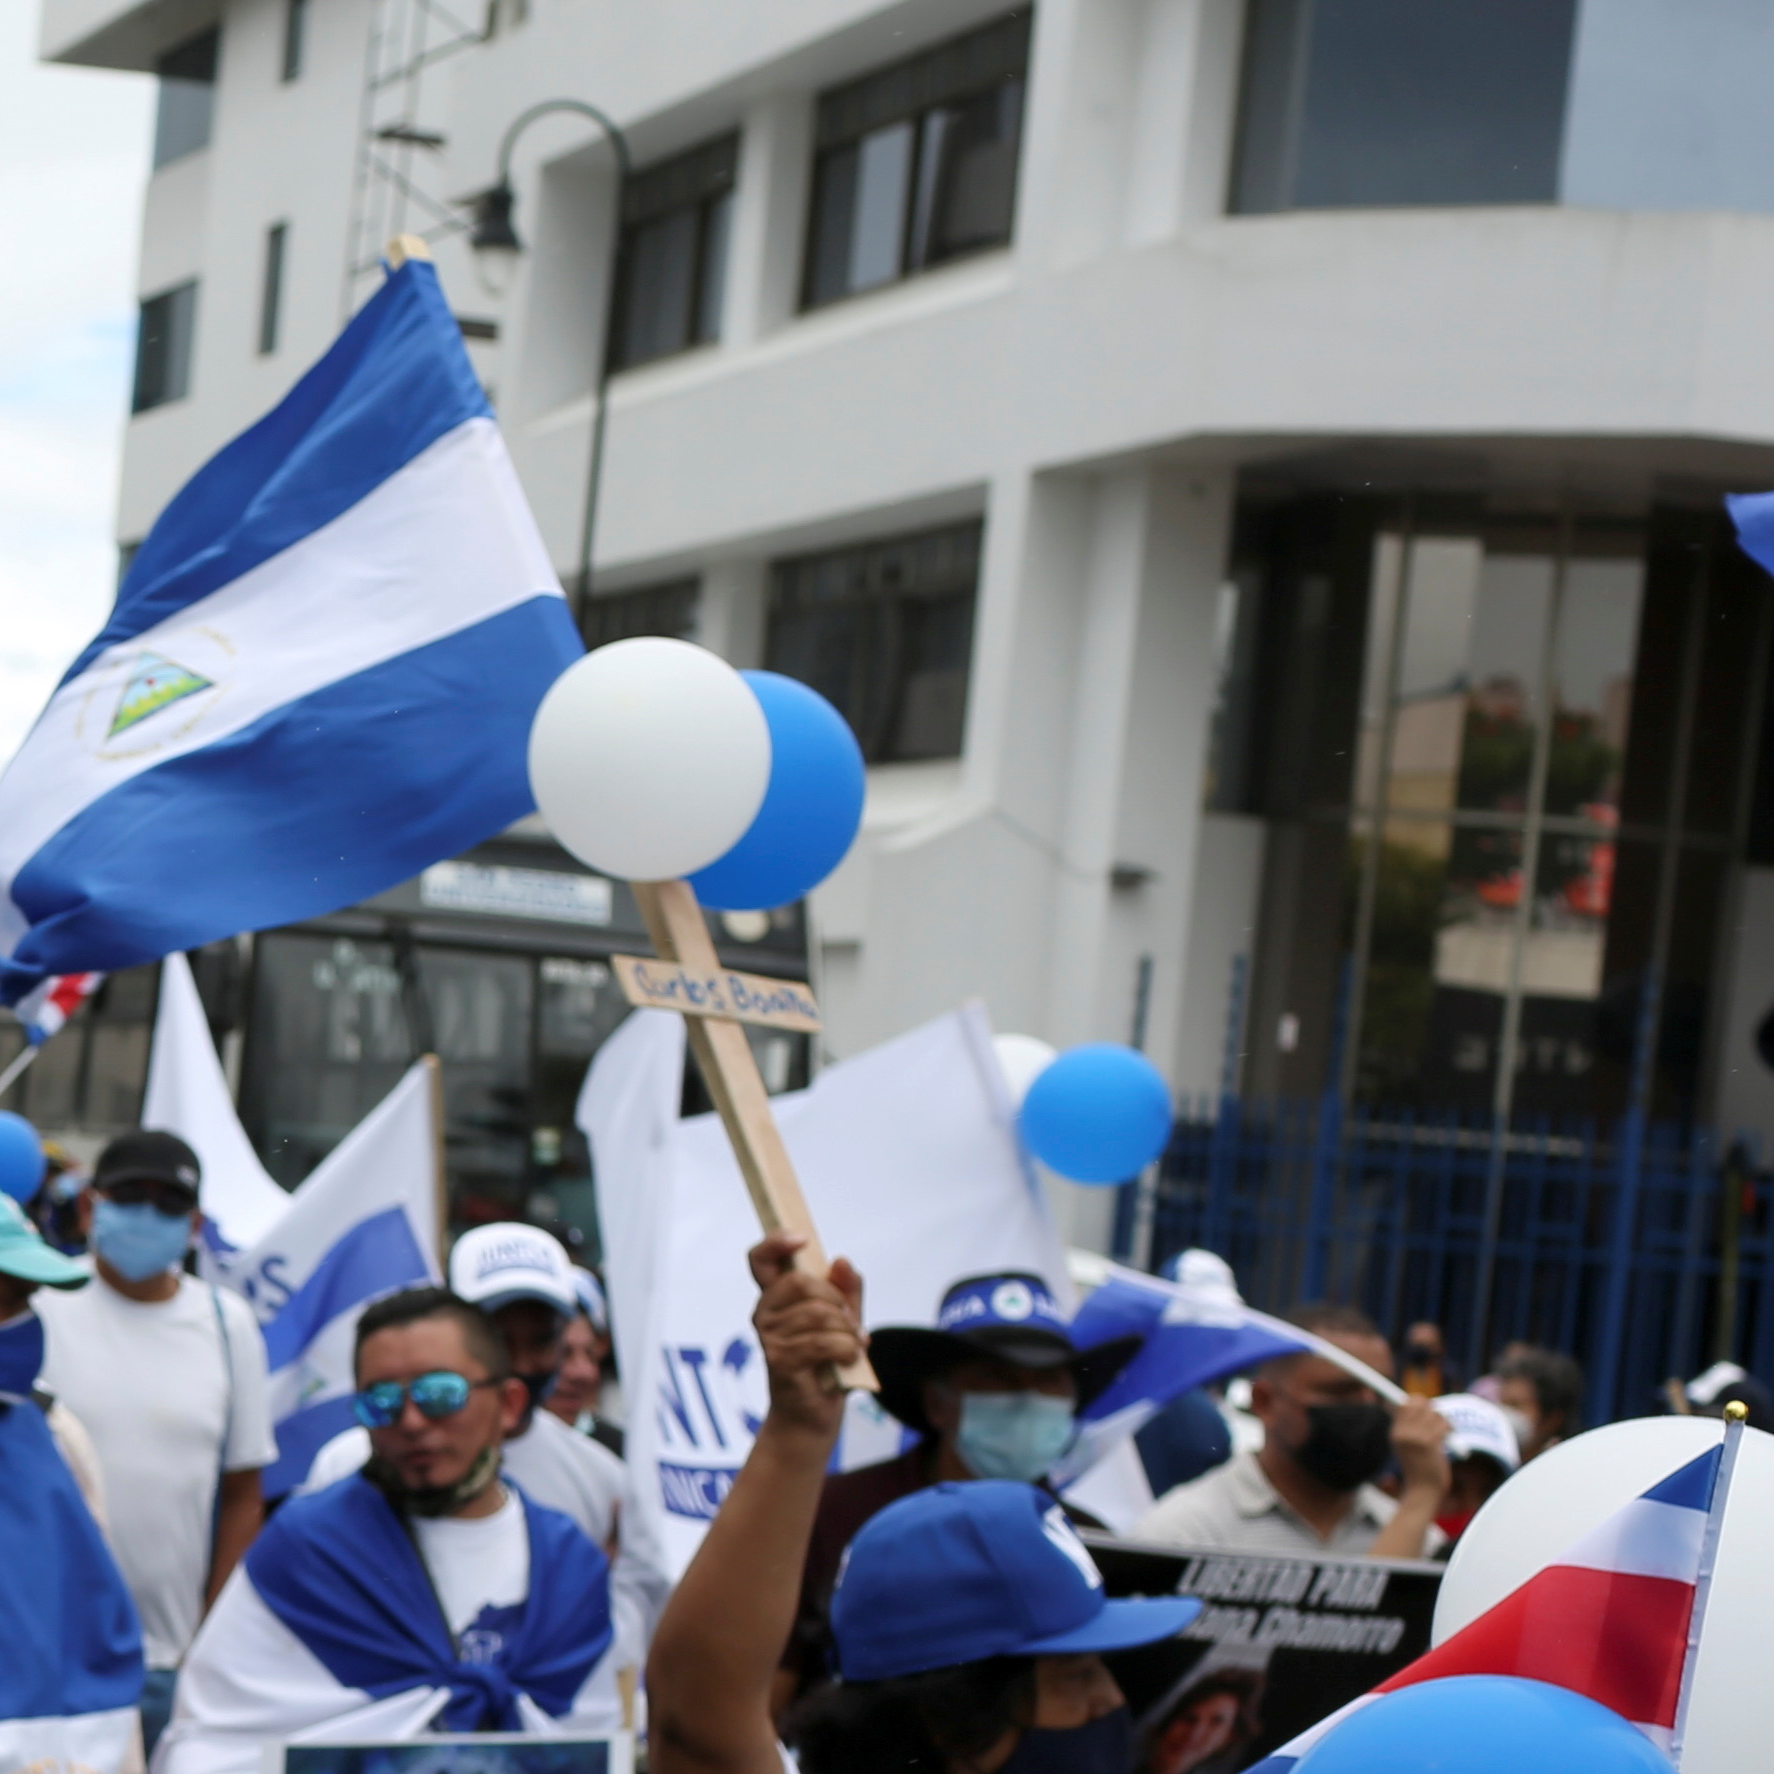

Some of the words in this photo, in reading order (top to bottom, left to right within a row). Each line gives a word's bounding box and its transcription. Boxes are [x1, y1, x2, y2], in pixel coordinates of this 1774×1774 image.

[1177, 1556, 1313, 1601] LIBERTAD
[1310, 1564, 1390, 1610] PARA
[1259, 1605, 1405, 1655] Chamorro
